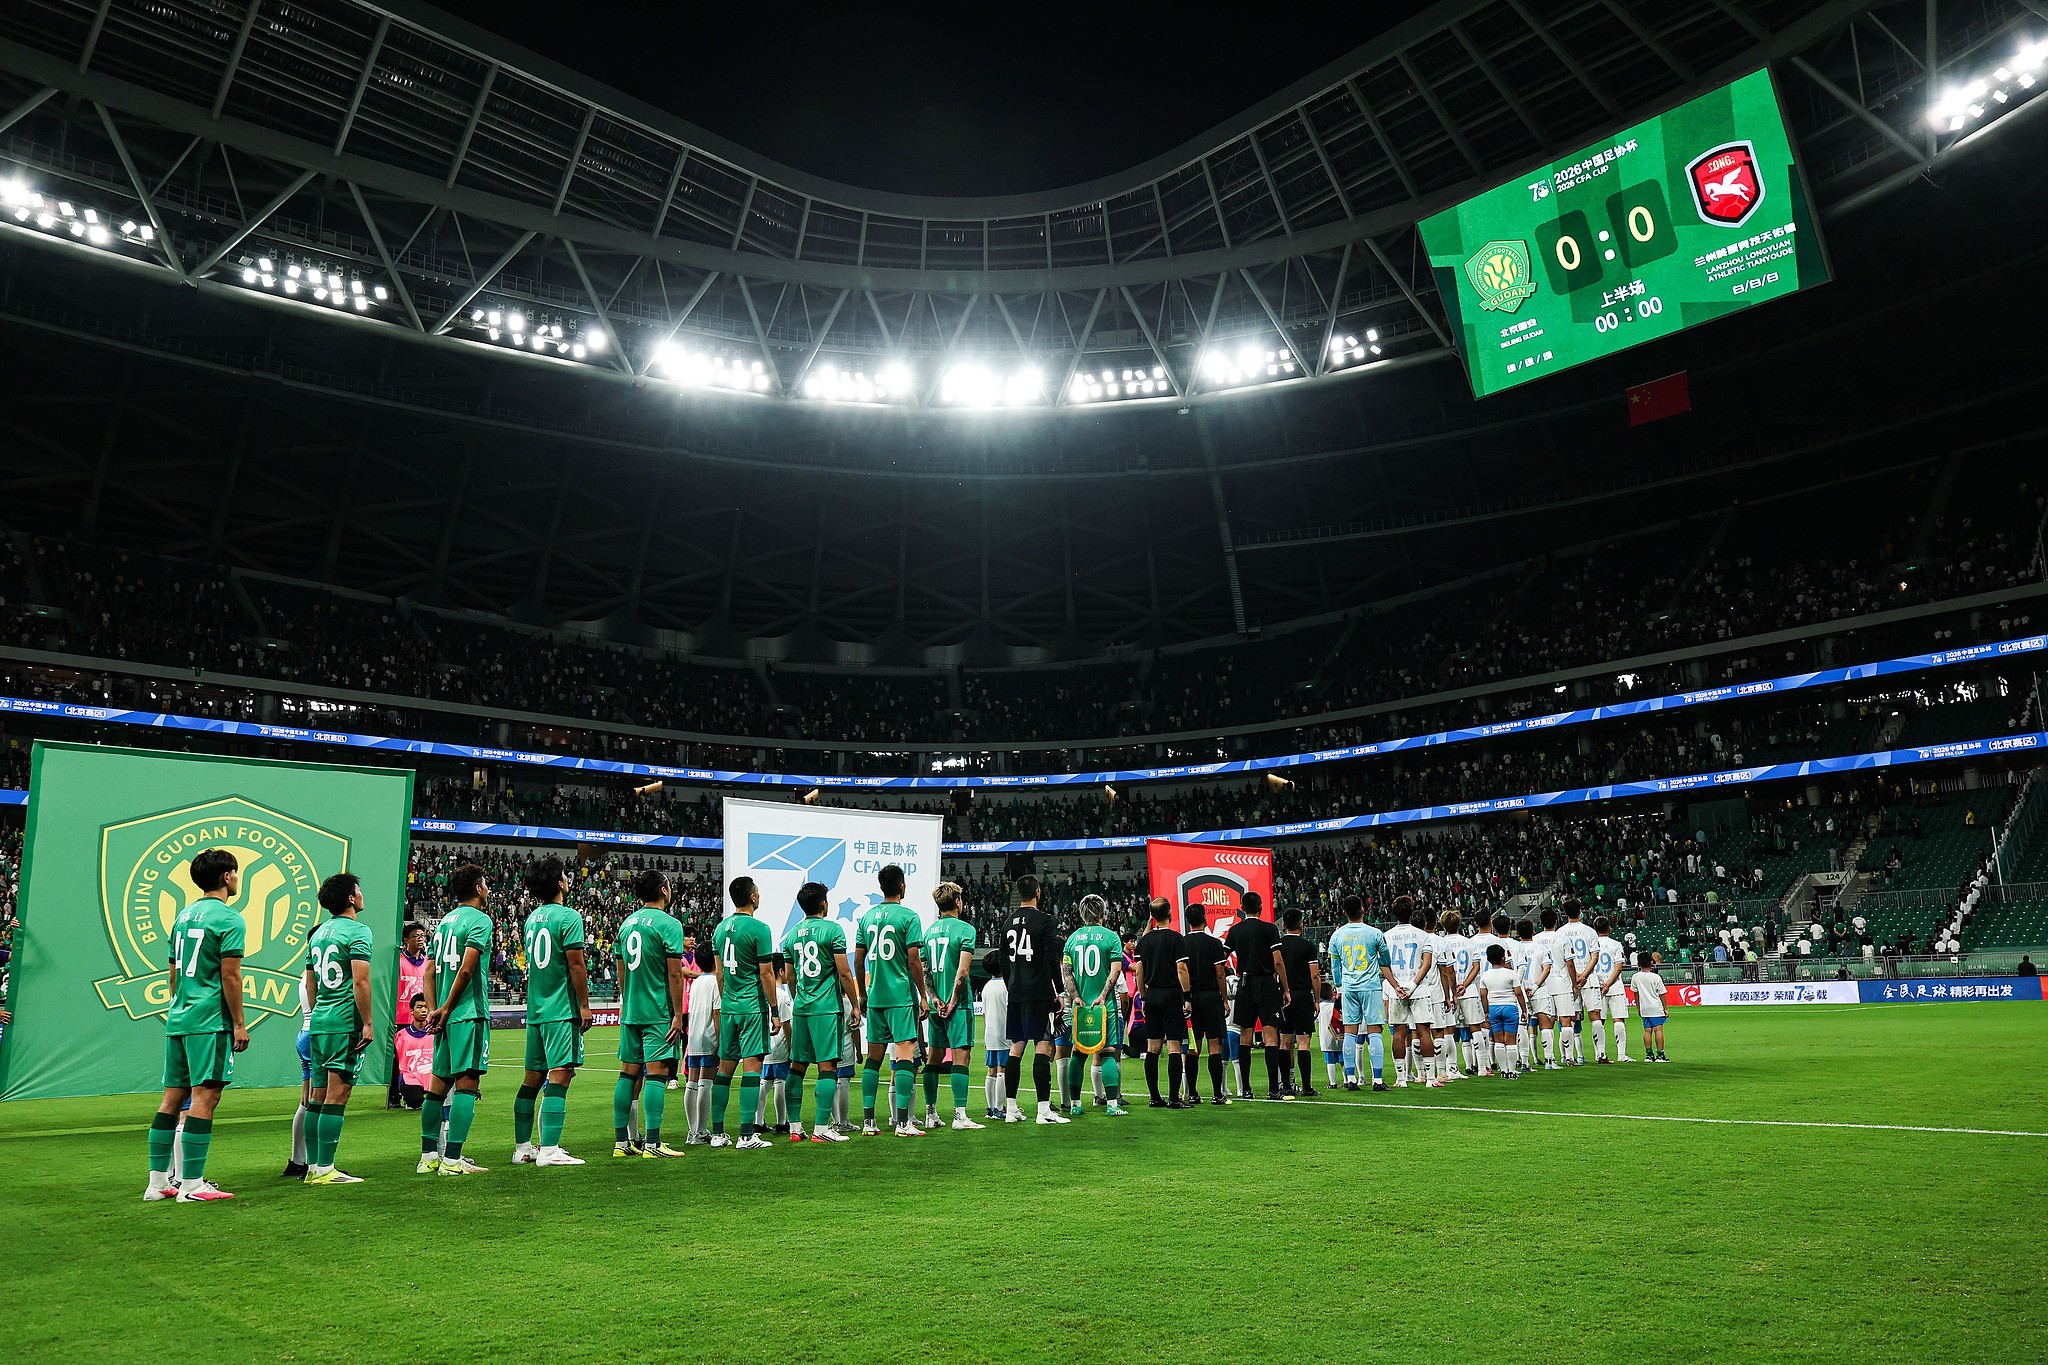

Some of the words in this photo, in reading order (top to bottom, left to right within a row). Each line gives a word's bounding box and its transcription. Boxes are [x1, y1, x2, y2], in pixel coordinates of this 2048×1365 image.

[1553, 139, 1638, 184] 2026中国足协杯
[1557, 180, 1575, 192] 2026
[1576, 173, 1592, 184] CFA
[1592, 165, 1609, 176] CUP
[1556, 235, 1580, 271] 0
[1628, 205, 1655, 242] 0
[1706, 255, 1744, 274] LANZHOU
[1745, 239, 1791, 261] LONGYUAN
[1708, 264, 1745, 283] ATHLETIC
[1746, 247, 1794, 269] TIANYOUDE
[1490, 287, 1526, 306] GUOAN
[1601, 278, 1646, 308] 上半场
[1932, 741, 1982, 754] 2026中国足协杯
[1988, 735, 2038, 751] （北京赛区）
[854, 840, 918, 857] 中国足协杯
[853, 860, 881, 874] CFA
[888, 862, 917, 876] UP
[134, 867, 158, 945] BEIJING
[156, 825, 228, 865] GUOAN
[237, 826, 309, 895] FOOTBALL
[284, 902, 311, 947] CLUB
[175, 928, 205, 977] 47
[432, 929, 461, 974] 24
[626, 930, 642, 972] 9
[723, 937, 738, 975] 4
[794, 940, 822, 978] 18
[867, 924, 896, 961] 26
[928, 937, 950, 973] 17
[1006, 928, 1034, 962] 34
[1343, 944, 1369, 972] 13
[1391, 943, 1418, 970] 47
[1570, 938, 1587, 960] 9
[311, 944, 343, 990] 36
[1074, 944, 1101, 977] 10
[1456, 950, 1469, 974] 9
[143, 975, 291, 1005] GAN
[1729, 990, 1771, 1002] 绿茵逐梦
[1883, 983, 2013, 999] 全民足球精彩再出发
[591, 1012, 621, 1026] 球中
